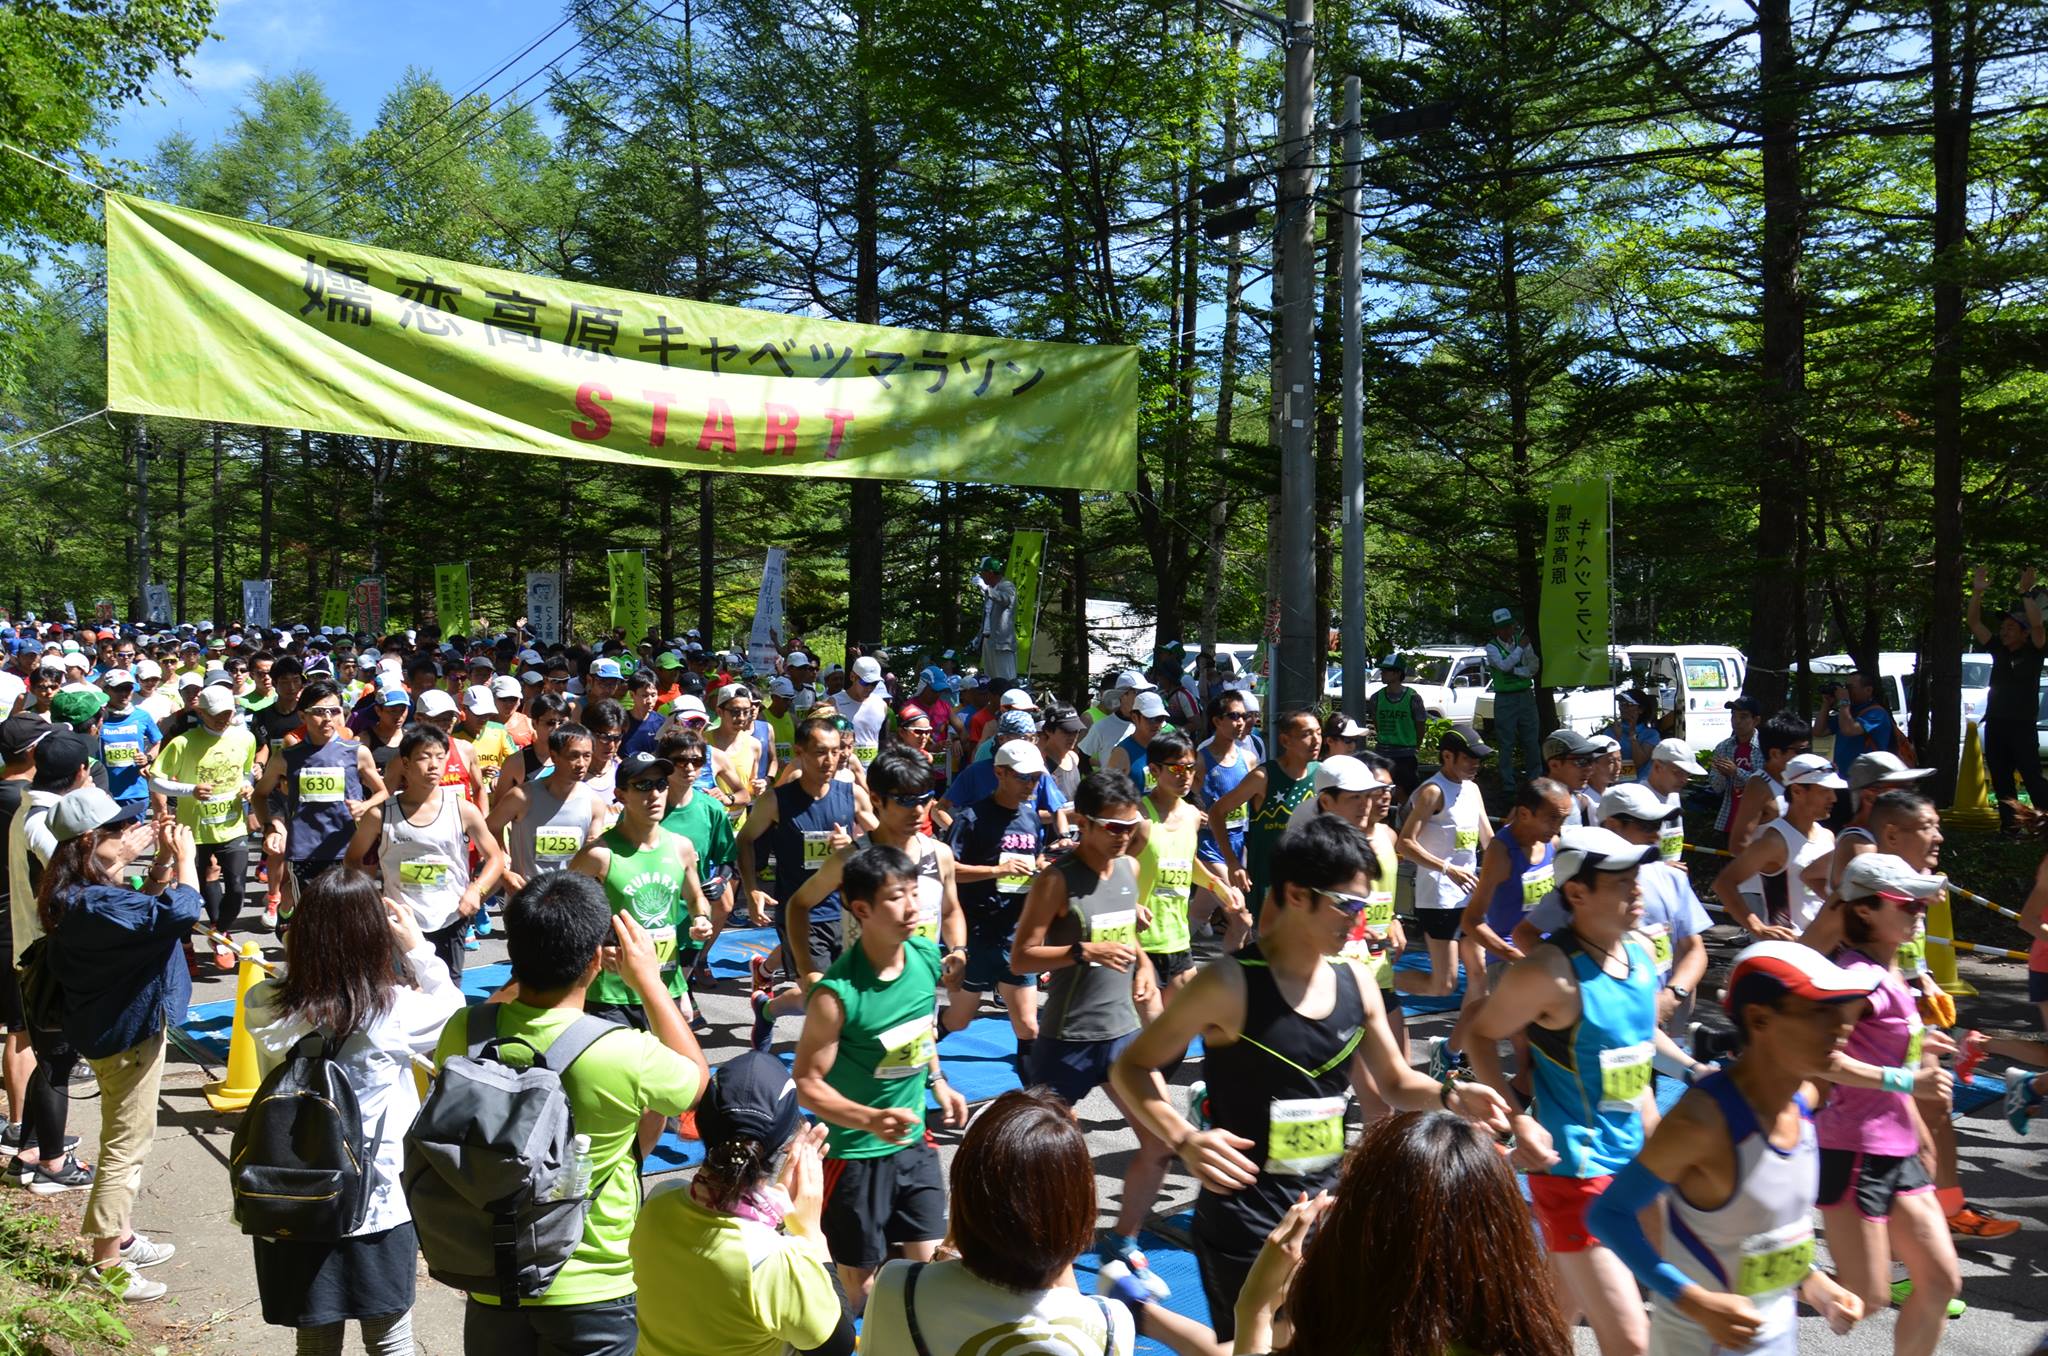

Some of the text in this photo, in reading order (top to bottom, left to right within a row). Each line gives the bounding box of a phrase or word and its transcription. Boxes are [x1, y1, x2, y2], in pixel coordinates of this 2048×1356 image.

[570, 382, 854, 460] START
[1379, 710, 1408, 720] STAFF
[108, 749, 135, 760] 1836
[306, 777, 335, 791] 630
[540, 836, 577, 851] 1253
[414, 865, 434, 880] 72
[1160, 869, 1189, 885] 1252
